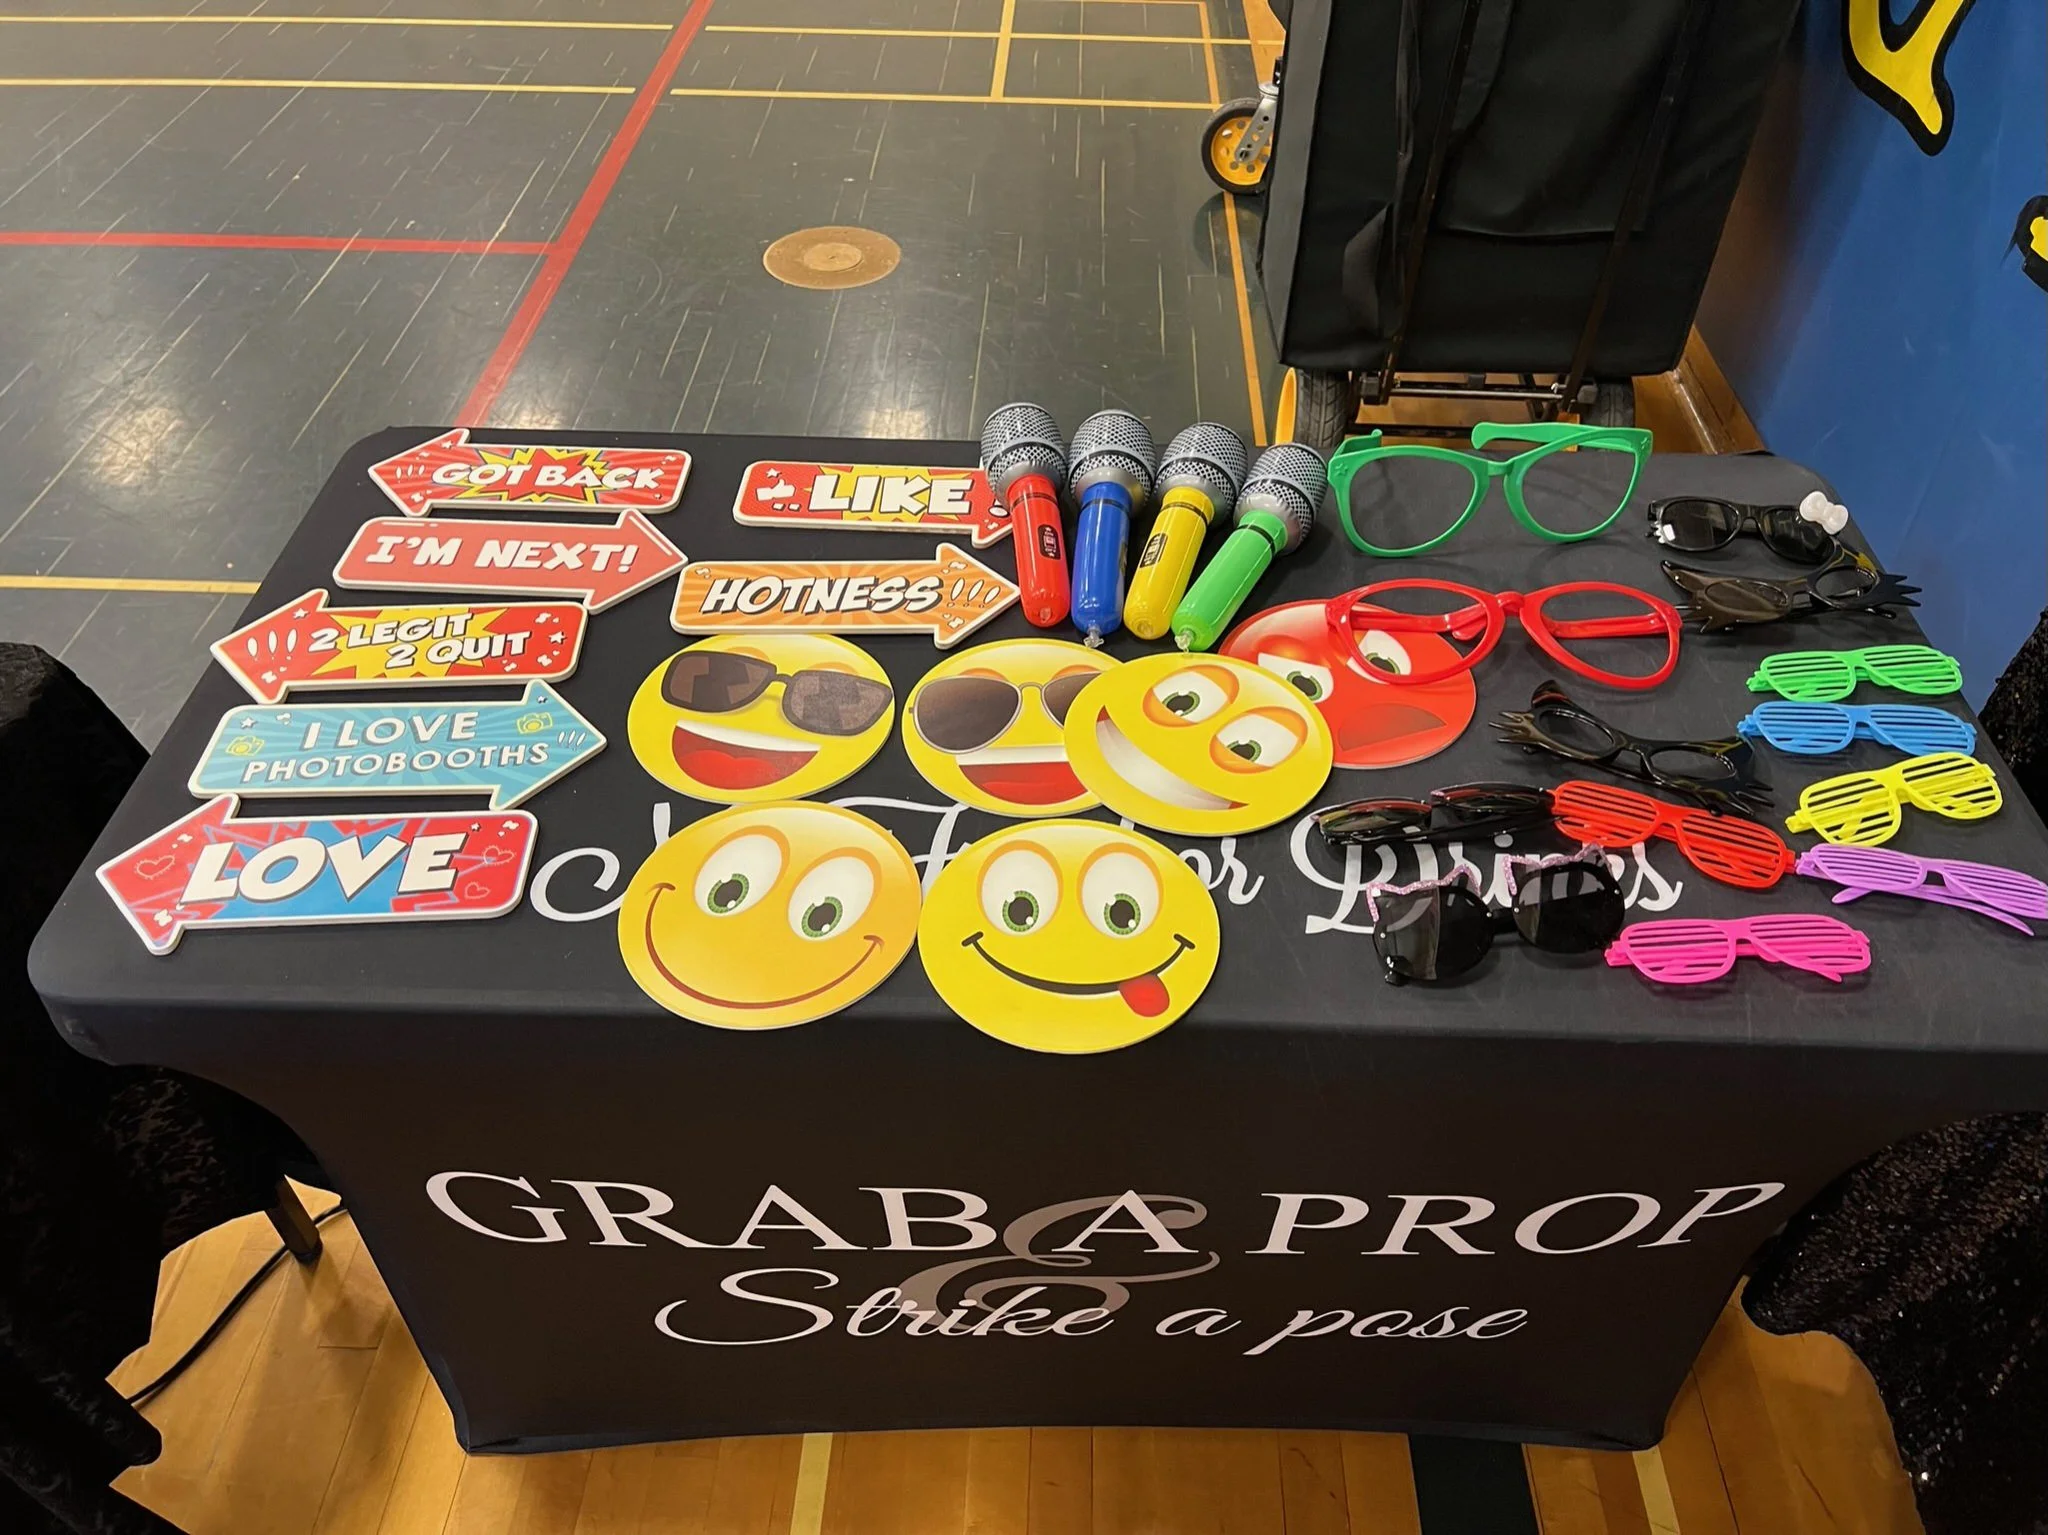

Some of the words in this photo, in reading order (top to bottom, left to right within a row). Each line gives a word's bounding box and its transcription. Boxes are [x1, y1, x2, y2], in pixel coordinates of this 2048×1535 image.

[432, 462, 534, 487] GOT
[535, 464, 665, 490] BACK
[808, 474, 974, 515] LIKE
[365, 535, 463, 567] I'M
[474, 539, 639, 574] NEXT!
[699, 575, 945, 616] HOTNESS
[307, 627, 340, 654] 2
[346, 611, 474, 649] LEGIT
[385, 645, 415, 671] 2
[426, 631, 532, 664] QUIT
[300, 721, 321, 751] I
[334, 710, 480, 748] LOVE
[241, 742, 550, 785] PHOTOBOOTHS
[178, 831, 470, 905] LOVE
[426, 1170, 998, 1252] GRAB
[1051, 1189, 1200, 1254] A
[1245, 1181, 1786, 1256] PROP
[654, 1267, 1115, 1346] Strike
[1155, 1307, 1242, 1337] a
[1242, 1305, 1528, 1356] pose
